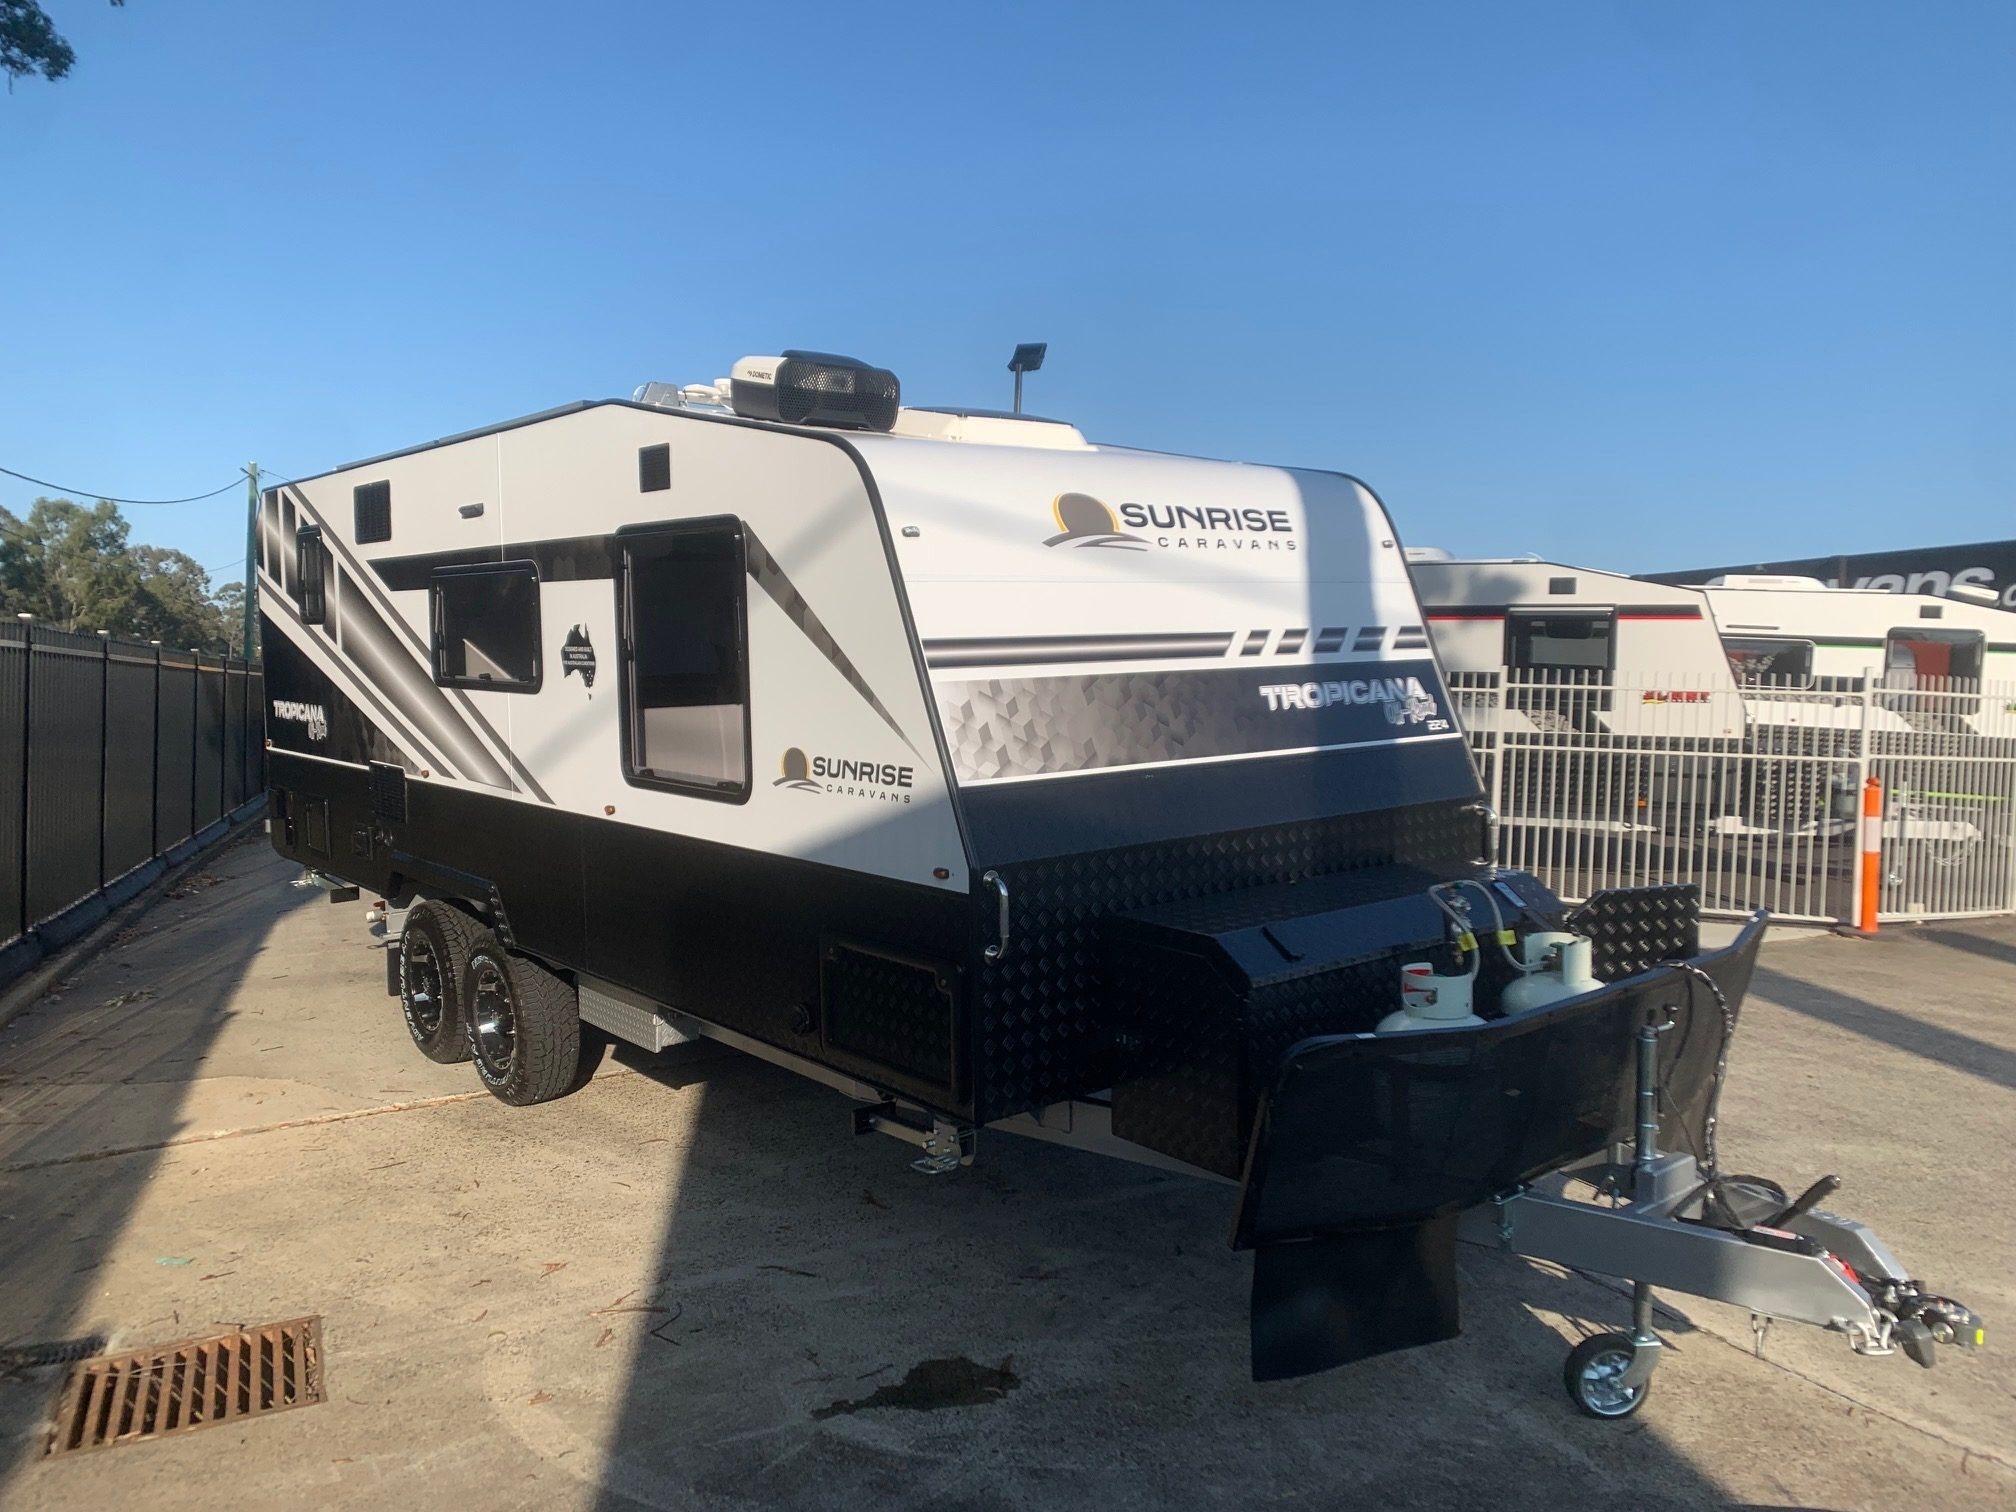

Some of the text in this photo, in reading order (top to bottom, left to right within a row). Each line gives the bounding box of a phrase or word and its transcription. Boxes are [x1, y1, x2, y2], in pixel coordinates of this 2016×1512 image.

[1119, 502, 1293, 533] SUNRISE
[1157, 536, 1297, 551] CARAVANS
[1259, 676, 1428, 711] TROPICANA
[273, 699, 325, 723] TROPICANA
[812, 756, 913, 788] SUNRISE
[826, 784, 911, 804] CARAVANS
